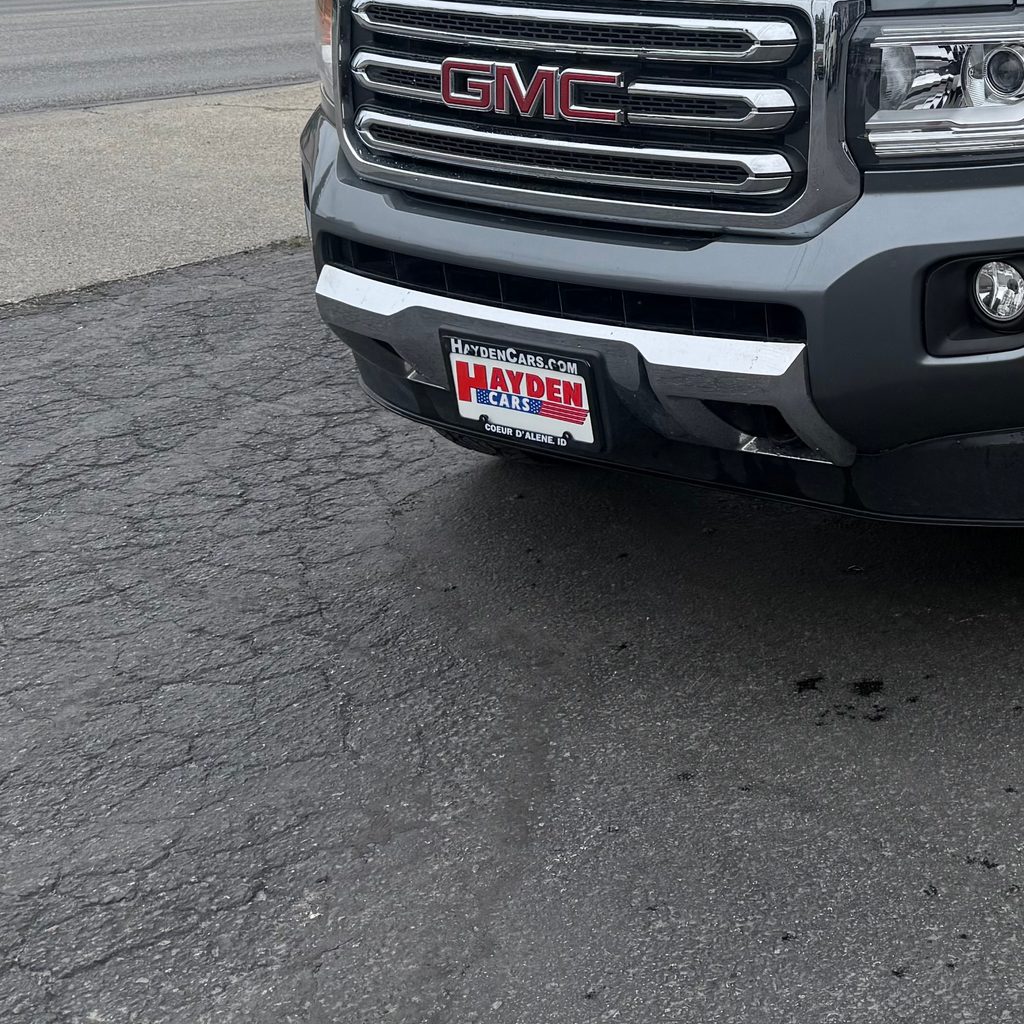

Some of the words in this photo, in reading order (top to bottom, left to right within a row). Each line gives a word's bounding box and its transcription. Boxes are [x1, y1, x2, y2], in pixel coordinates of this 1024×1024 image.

[441, 57, 624, 125] GMC
[456, 360, 583, 407] HAYDEN
[488, 391, 530, 412] CARS
[484, 423, 513, 436] COEUR
[557, 438, 567, 446] ID
